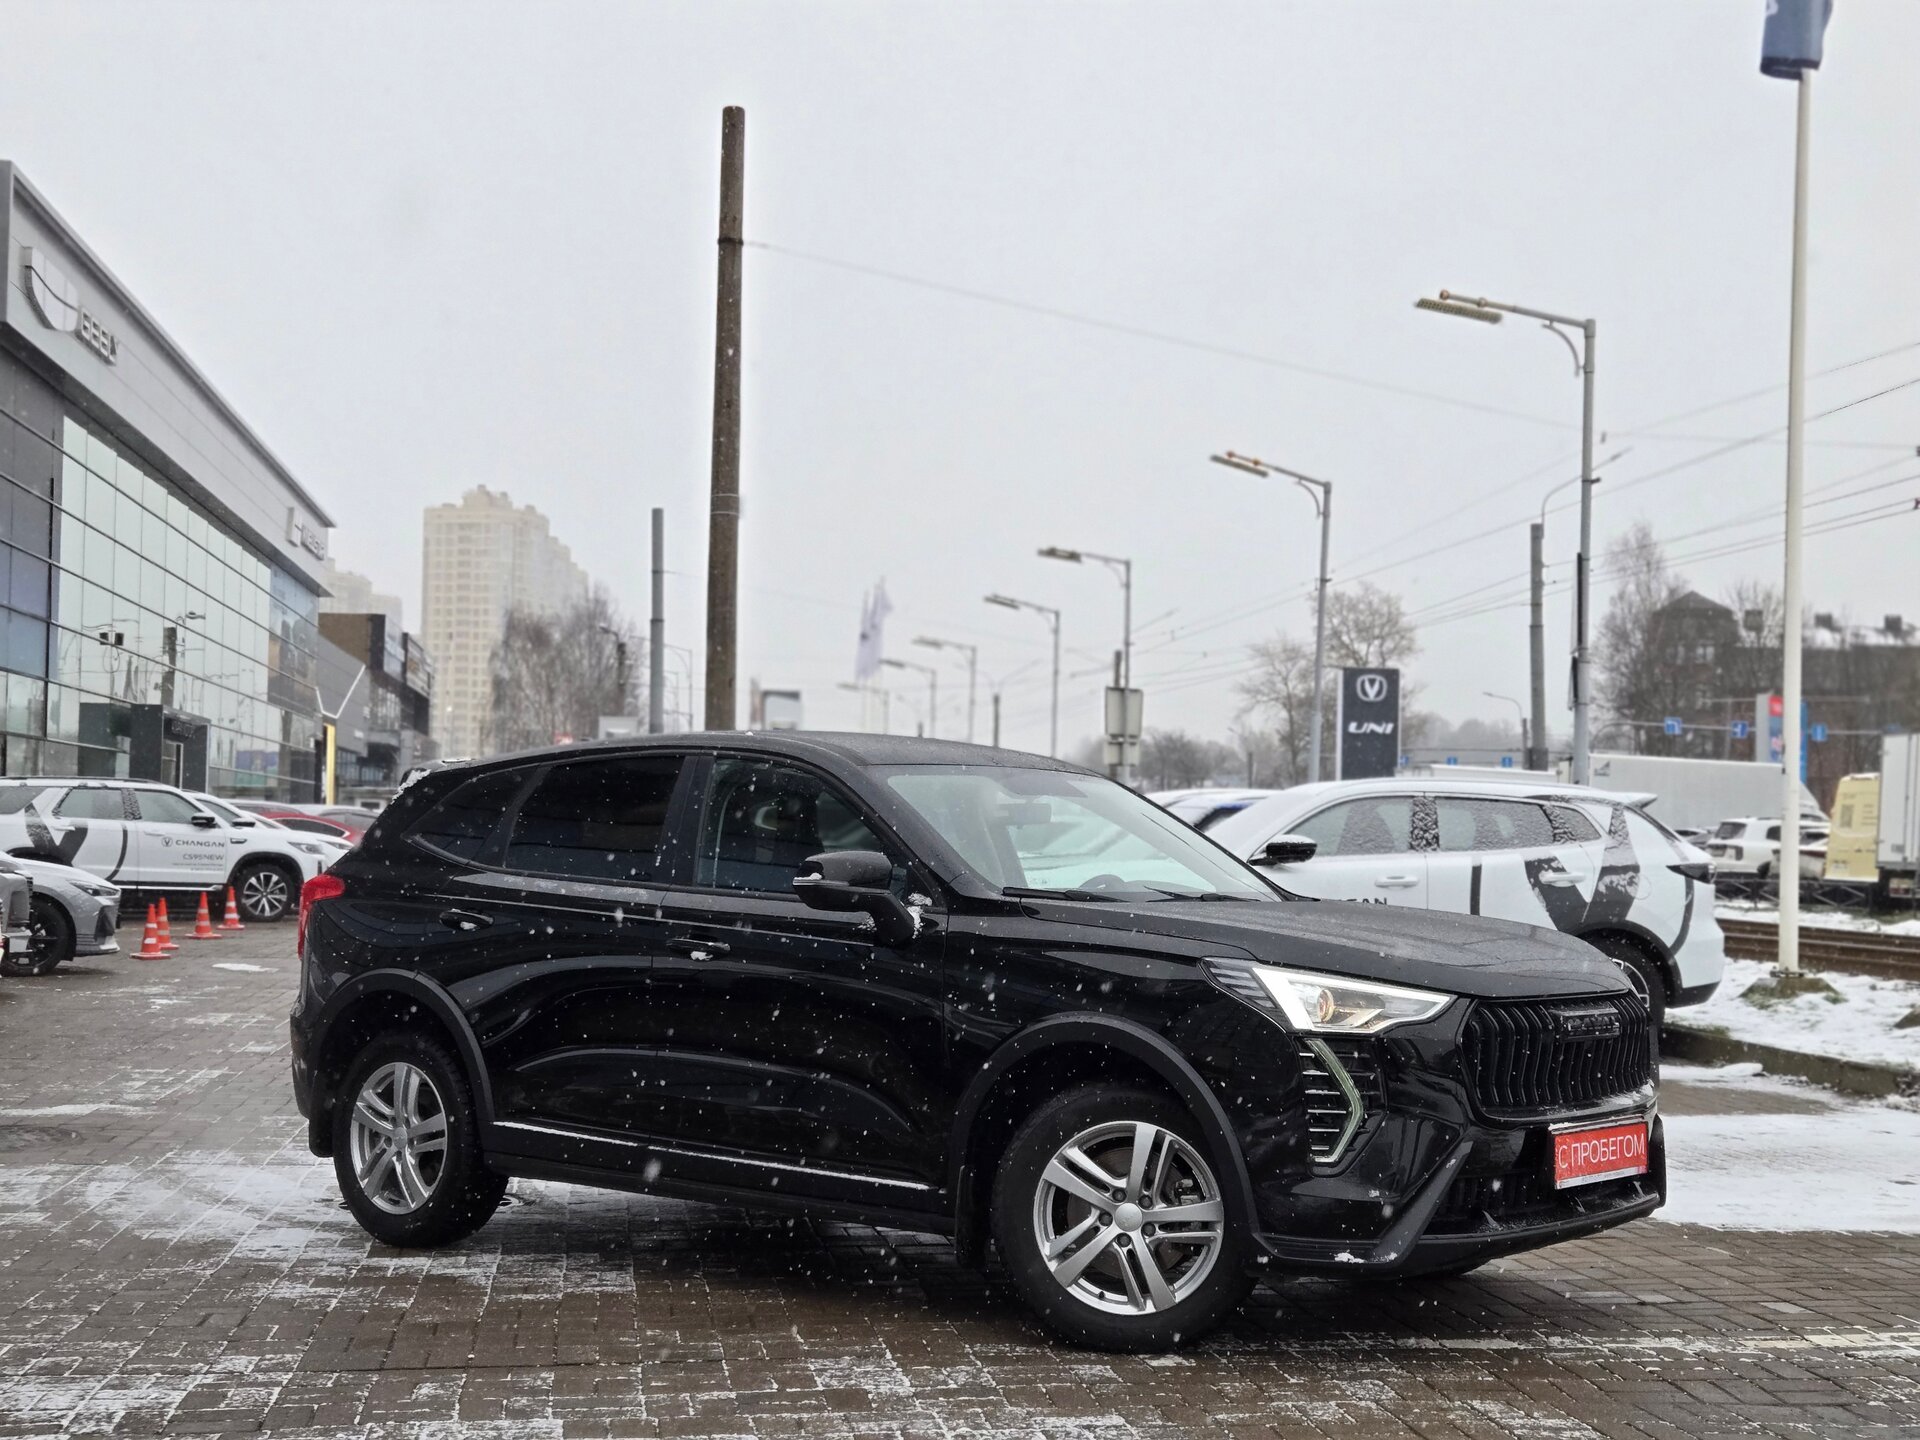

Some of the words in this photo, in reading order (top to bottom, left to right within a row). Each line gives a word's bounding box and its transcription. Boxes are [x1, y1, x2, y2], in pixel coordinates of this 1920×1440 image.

[1348, 721, 1394, 734] UNI
[175, 839, 225, 848] CHANGAN
[1558, 1144, 1568, 1169] С
[1571, 1133, 1645, 1167] ПРОБЕГОМ
